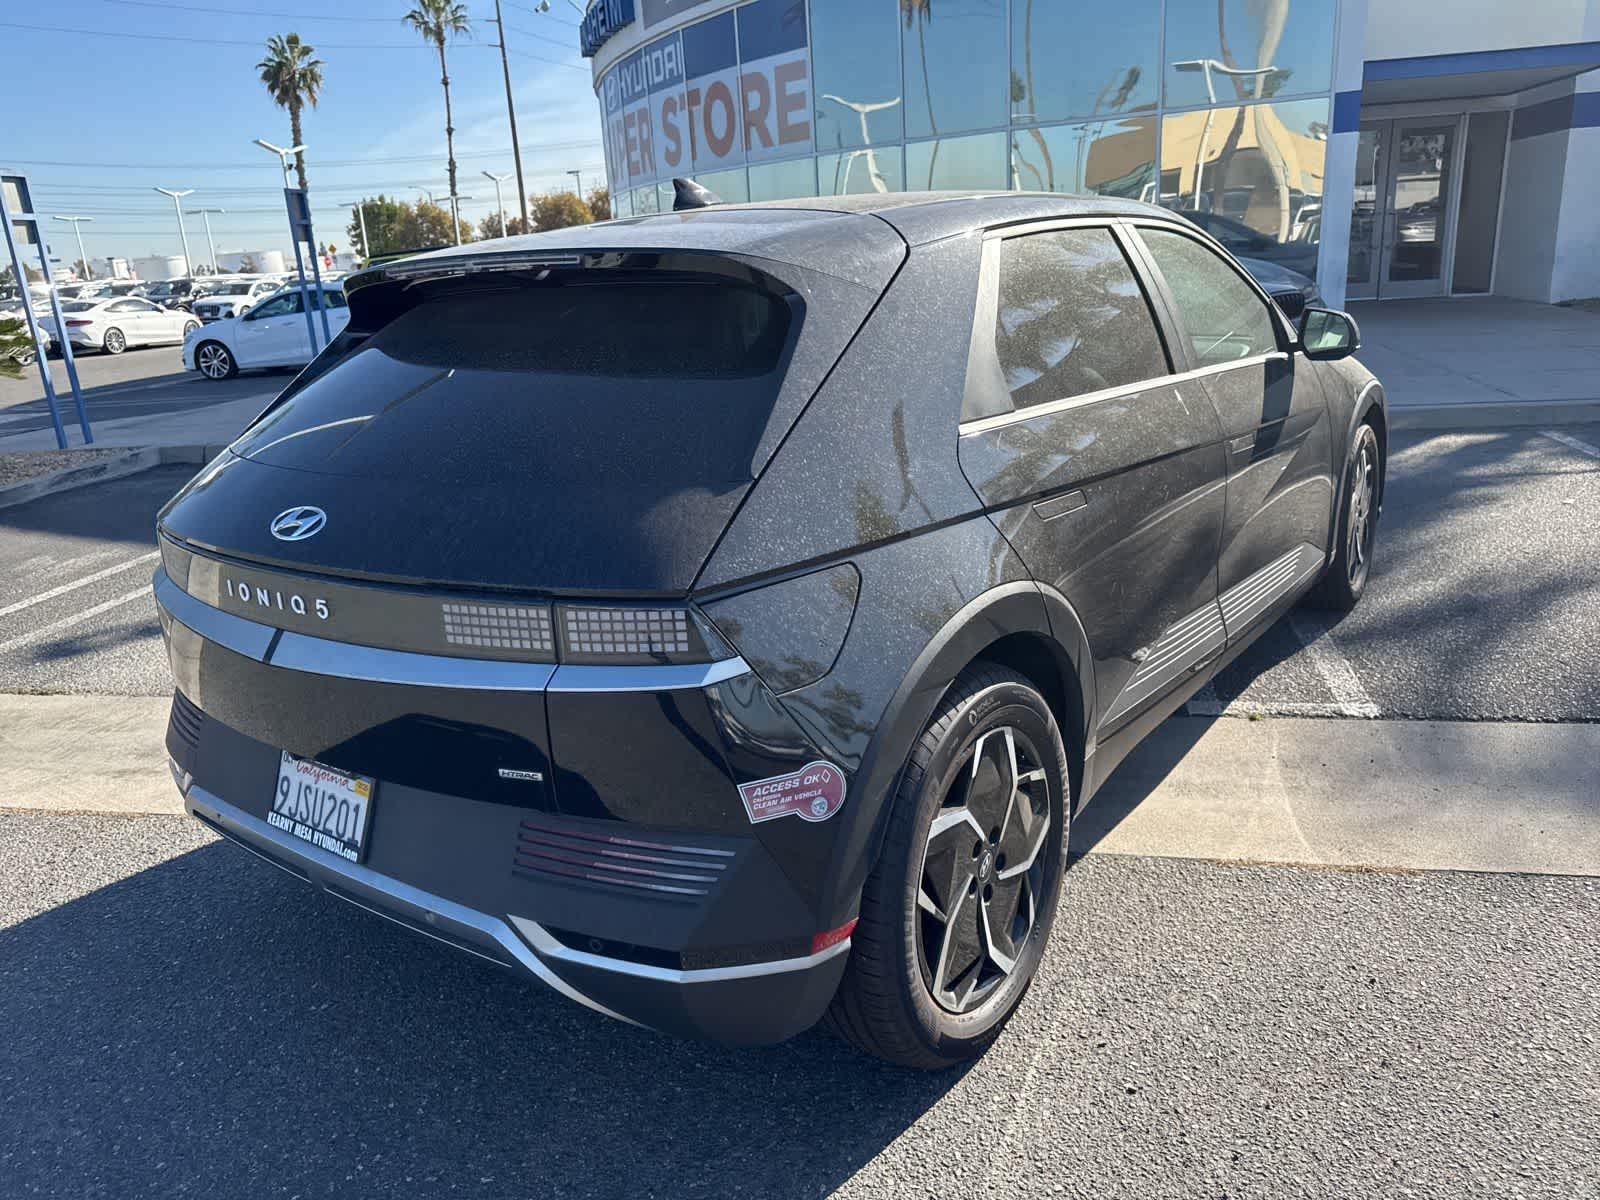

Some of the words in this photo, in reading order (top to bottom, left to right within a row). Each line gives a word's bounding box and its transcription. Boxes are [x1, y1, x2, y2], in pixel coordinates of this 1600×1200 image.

[661, 60, 811, 168] STORE
[226, 578, 306, 615] IONIQ
[315, 598, 329, 619] 5
[276, 775, 361, 841] 9JSU201
[752, 778, 800, 797] ACCESS
[803, 773, 821, 785] OK
[753, 798, 779, 810] CLEAN
[779, 796, 793, 804] AIR
[794, 788, 822, 801] VEHICLE
[266, 811, 294, 833] KEARNY
[293, 823, 312, 842] MESA
[312, 831, 359, 863] HYUNDAI.com
